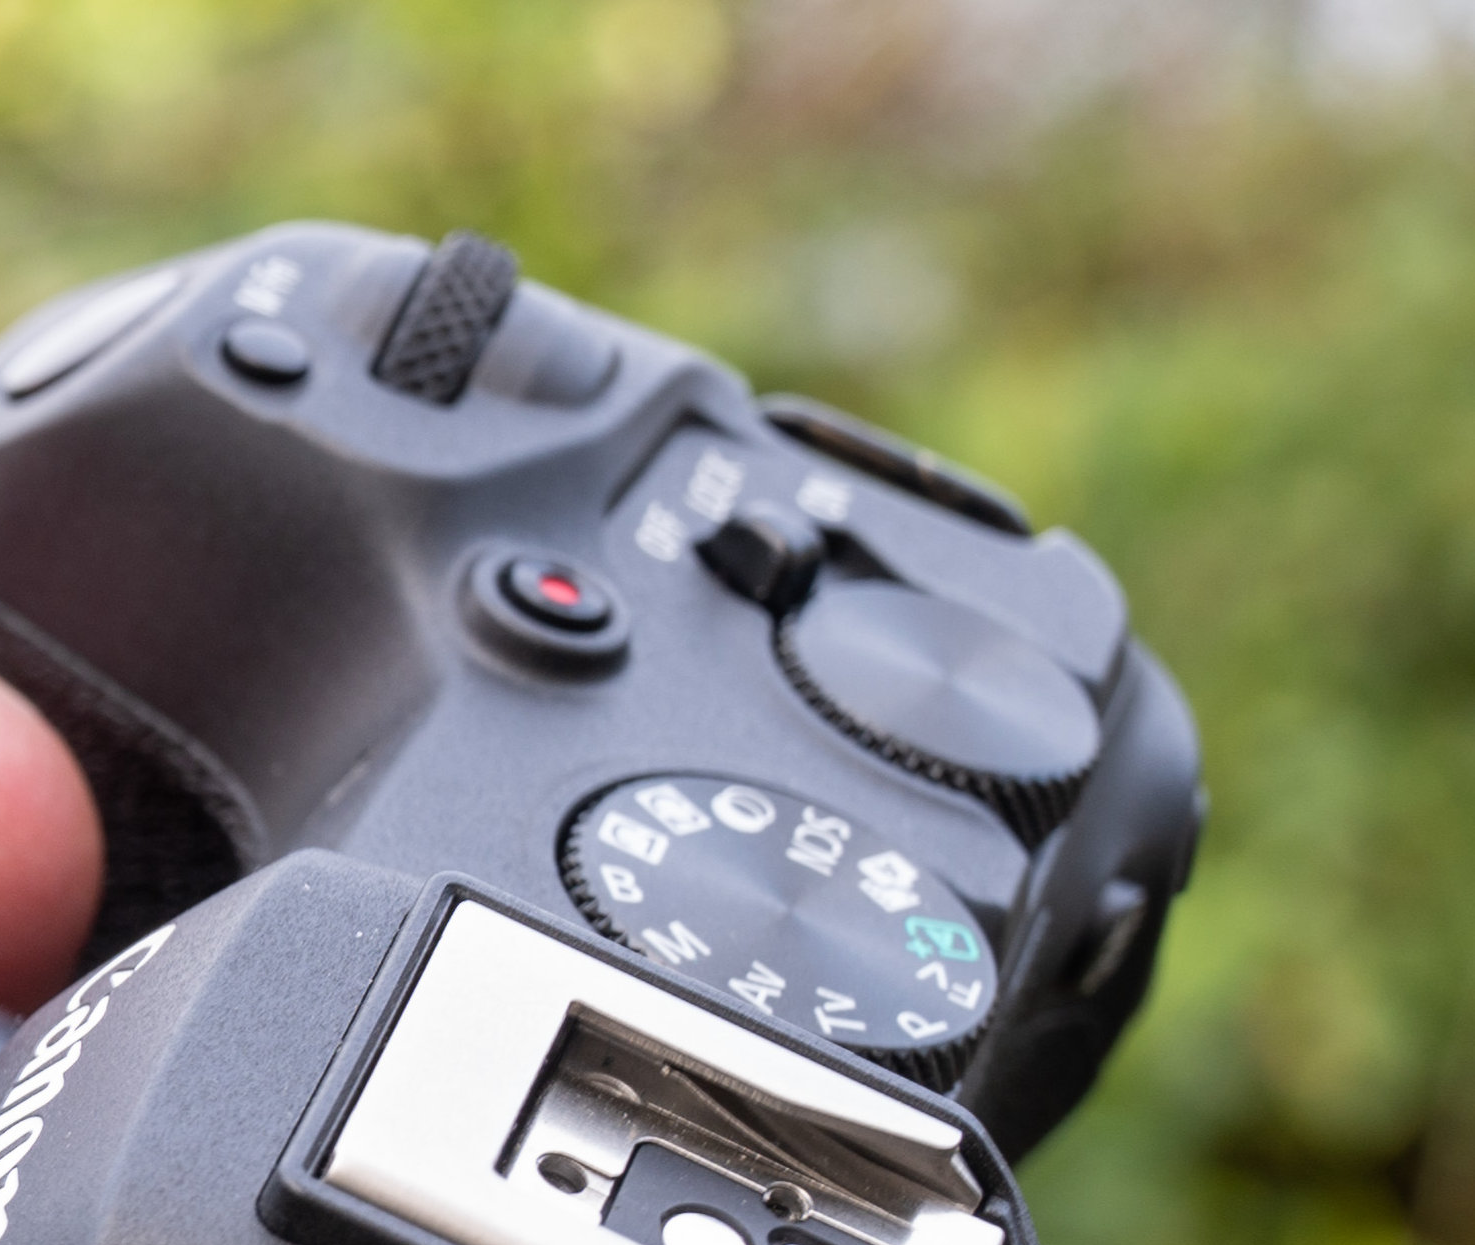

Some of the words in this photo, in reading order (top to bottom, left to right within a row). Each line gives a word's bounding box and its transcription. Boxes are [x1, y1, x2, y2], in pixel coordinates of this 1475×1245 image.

[600, 864, 643, 903] B
[642, 920, 711, 965] M
[728, 960, 786, 1015] Av
[915, 961, 982, 1010] Fv
[814, 986, 866, 1034] Tv
[896, 1011, 947, 1038] P
